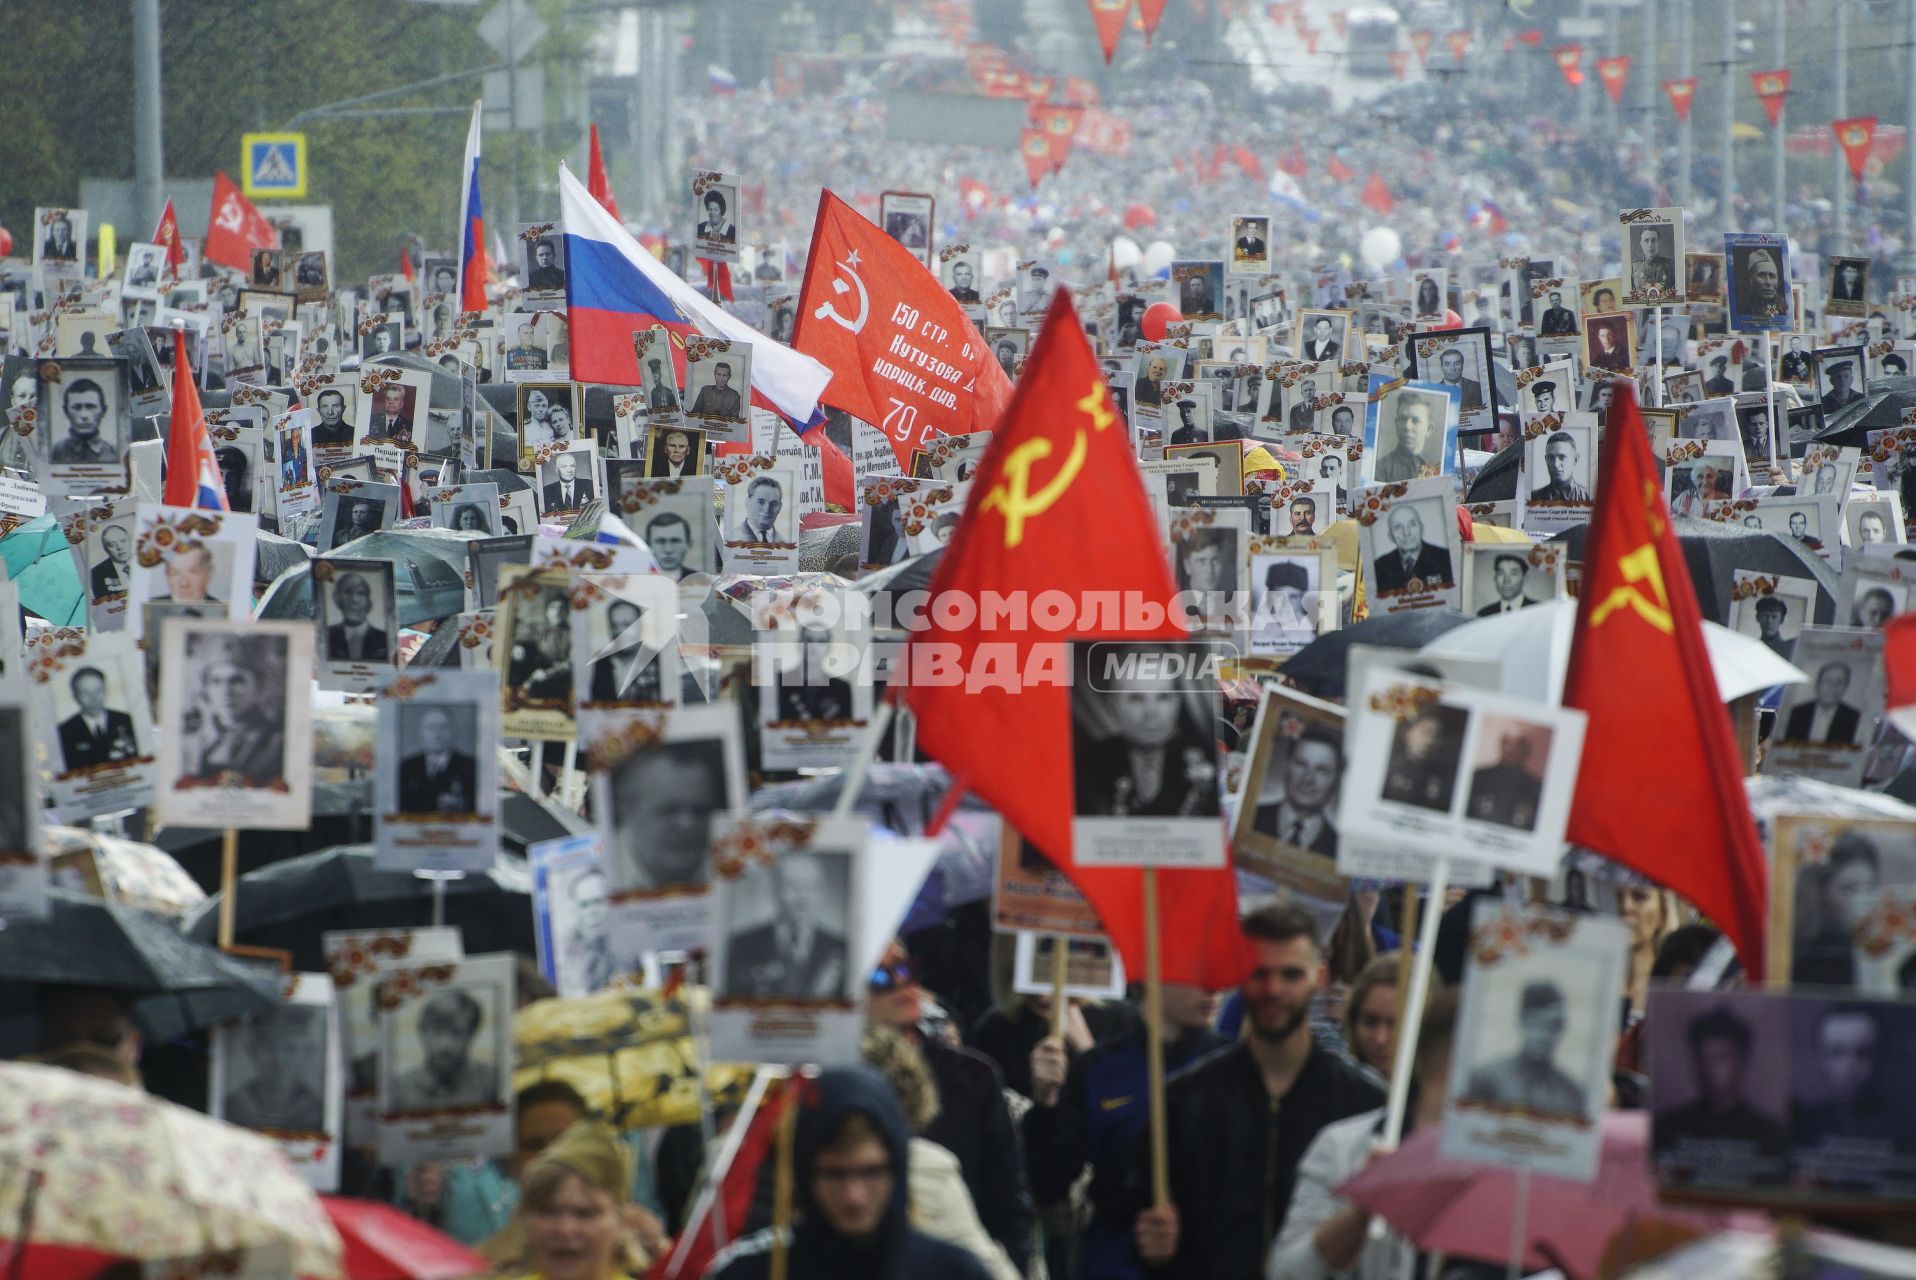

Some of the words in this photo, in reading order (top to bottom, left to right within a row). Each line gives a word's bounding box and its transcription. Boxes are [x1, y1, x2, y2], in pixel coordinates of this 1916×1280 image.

[891, 302, 920, 330] 150
[921, 321, 949, 348] СТР.
[872, 357, 927, 396] ИДРИЦК.
[928, 386, 957, 411] ДИВ.
[882, 396, 918, 442] 79
